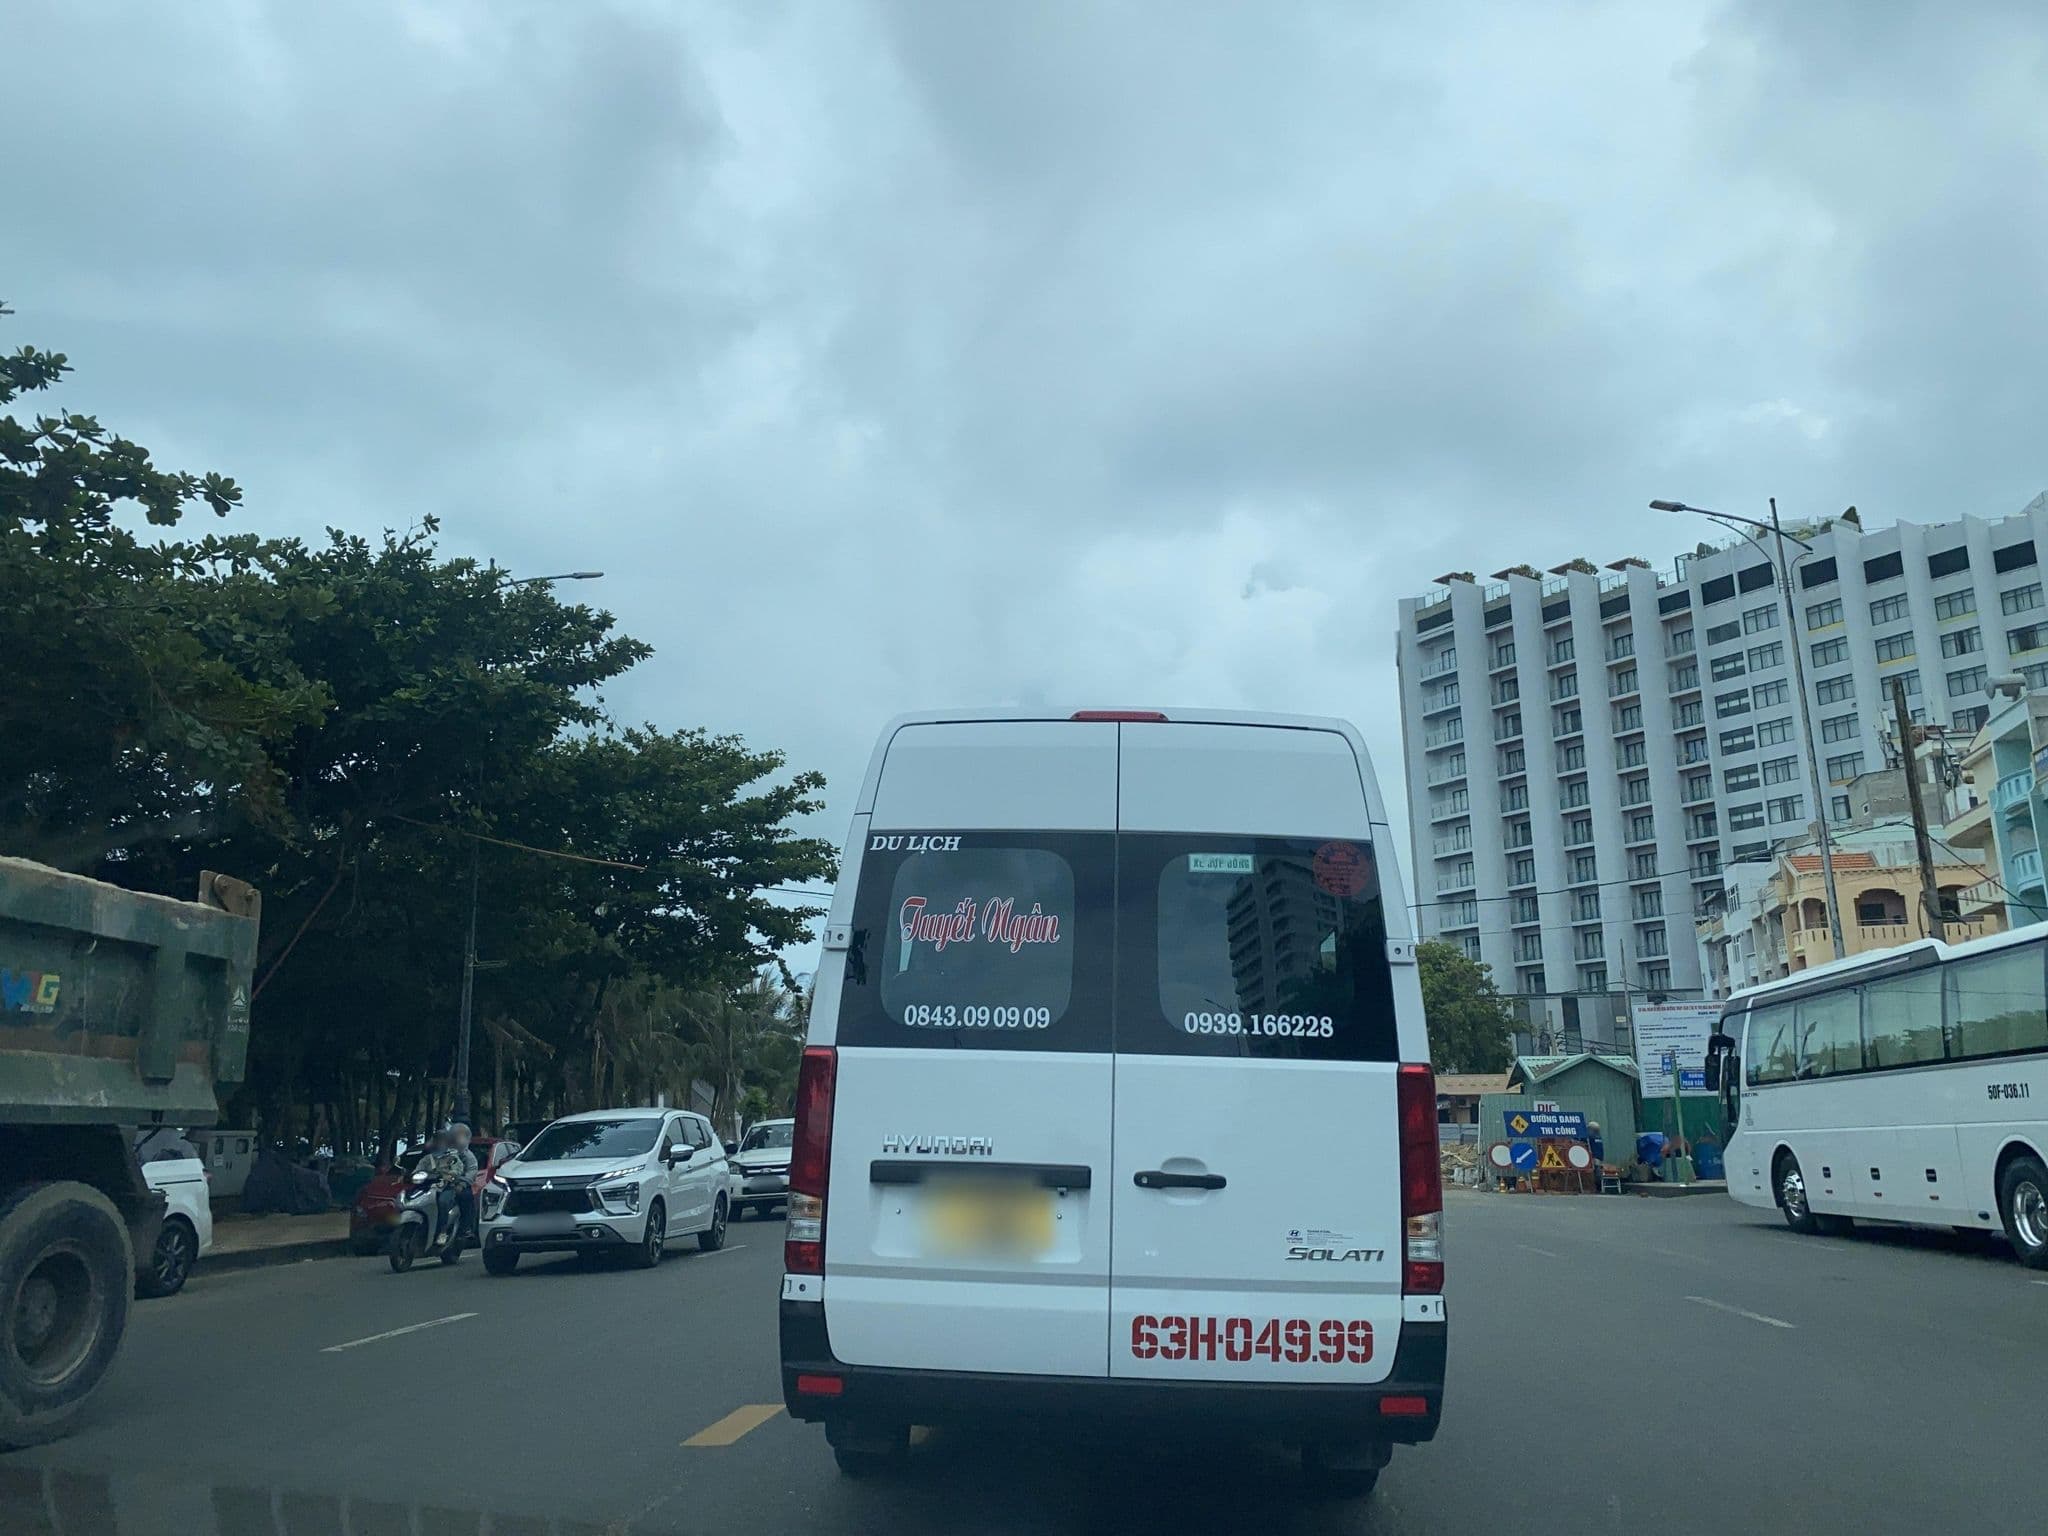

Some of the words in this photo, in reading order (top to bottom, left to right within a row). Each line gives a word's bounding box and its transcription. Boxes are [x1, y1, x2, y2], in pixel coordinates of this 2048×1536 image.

[870, 836, 904, 850] DU
[906, 836, 962, 854] LỊCH
[900, 896, 976, 952] Tuyết
[982, 897, 1060, 953] Ngân
[1184, 1012, 1334, 1038] 0939.166228
[1540, 1126, 1553, 1135] THI
[883, 1134, 993, 1156] HYUNDAI
[1284, 1246, 1385, 1262] SOLATI
